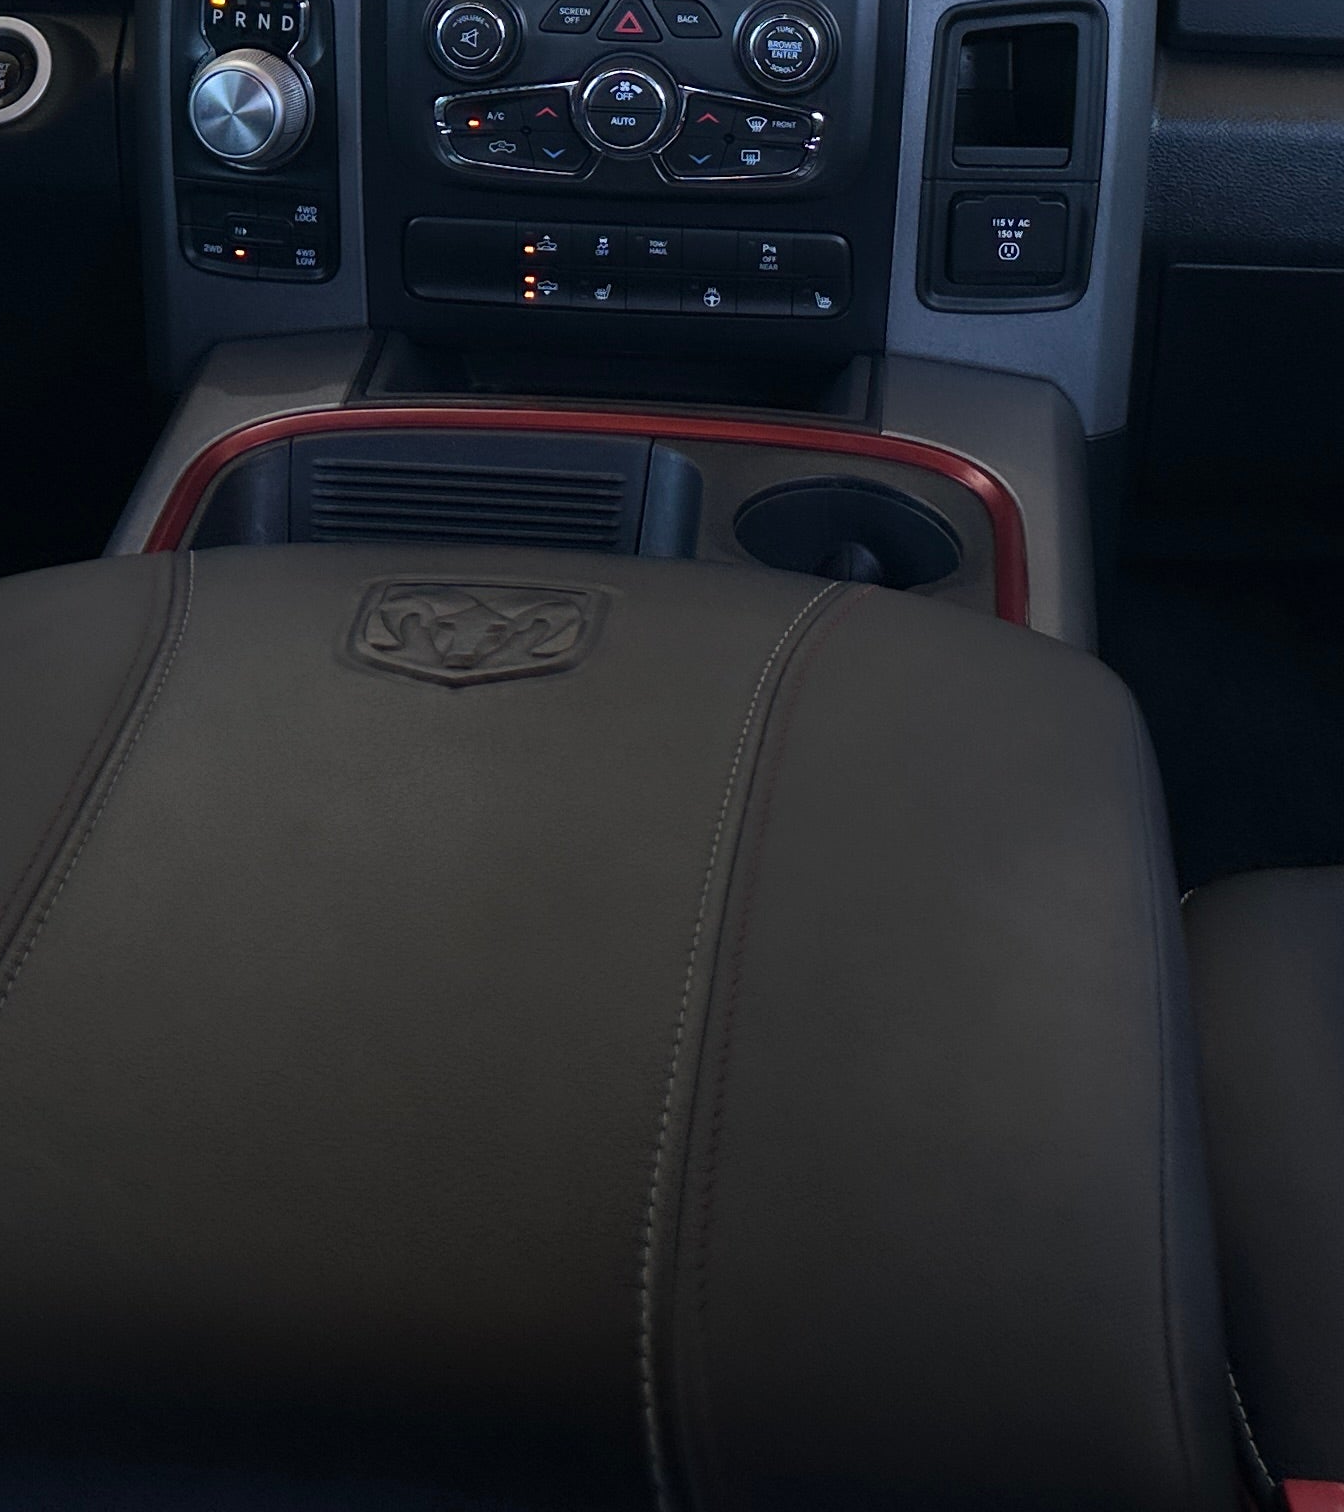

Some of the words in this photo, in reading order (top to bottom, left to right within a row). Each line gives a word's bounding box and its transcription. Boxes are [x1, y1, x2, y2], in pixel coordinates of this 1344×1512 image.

[559, 7, 591, 16] SCREEN
[212, 8, 224, 24] P
[236, 11, 246, 28] R
[258, 13, 271, 29] N
[281, 15, 294, 31] D
[457, 15, 485, 24] VOLUME
[564, 16, 580, 24] OFF
[676, 15, 699, 24] BACK
[776, 26, 795, 35] TUNE
[767, 40, 802, 49] BROWSE
[771, 50, 798, 60] ENTER
[770, 64, 796, 74] SCROLL
[615, 92, 634, 101] OFF
[486, 111, 505, 121] A/C
[610, 117, 636, 126] AUTO
[771, 120, 797, 129] FRONT
[296, 205, 317, 215] 4WD
[294, 214, 317, 223] LOCK
[992, 218, 1006, 227] 115
[1007, 218, 1015, 227] V
[1017, 219, 1031, 227] AC
[997, 229, 1013, 238] 150
[1013, 230, 1024, 239] W
[203, 243, 223, 253] 2WD
[295, 249, 316, 258] 4WD
[295, 257, 316, 266] LOW
[762, 255, 776, 263] OFF
